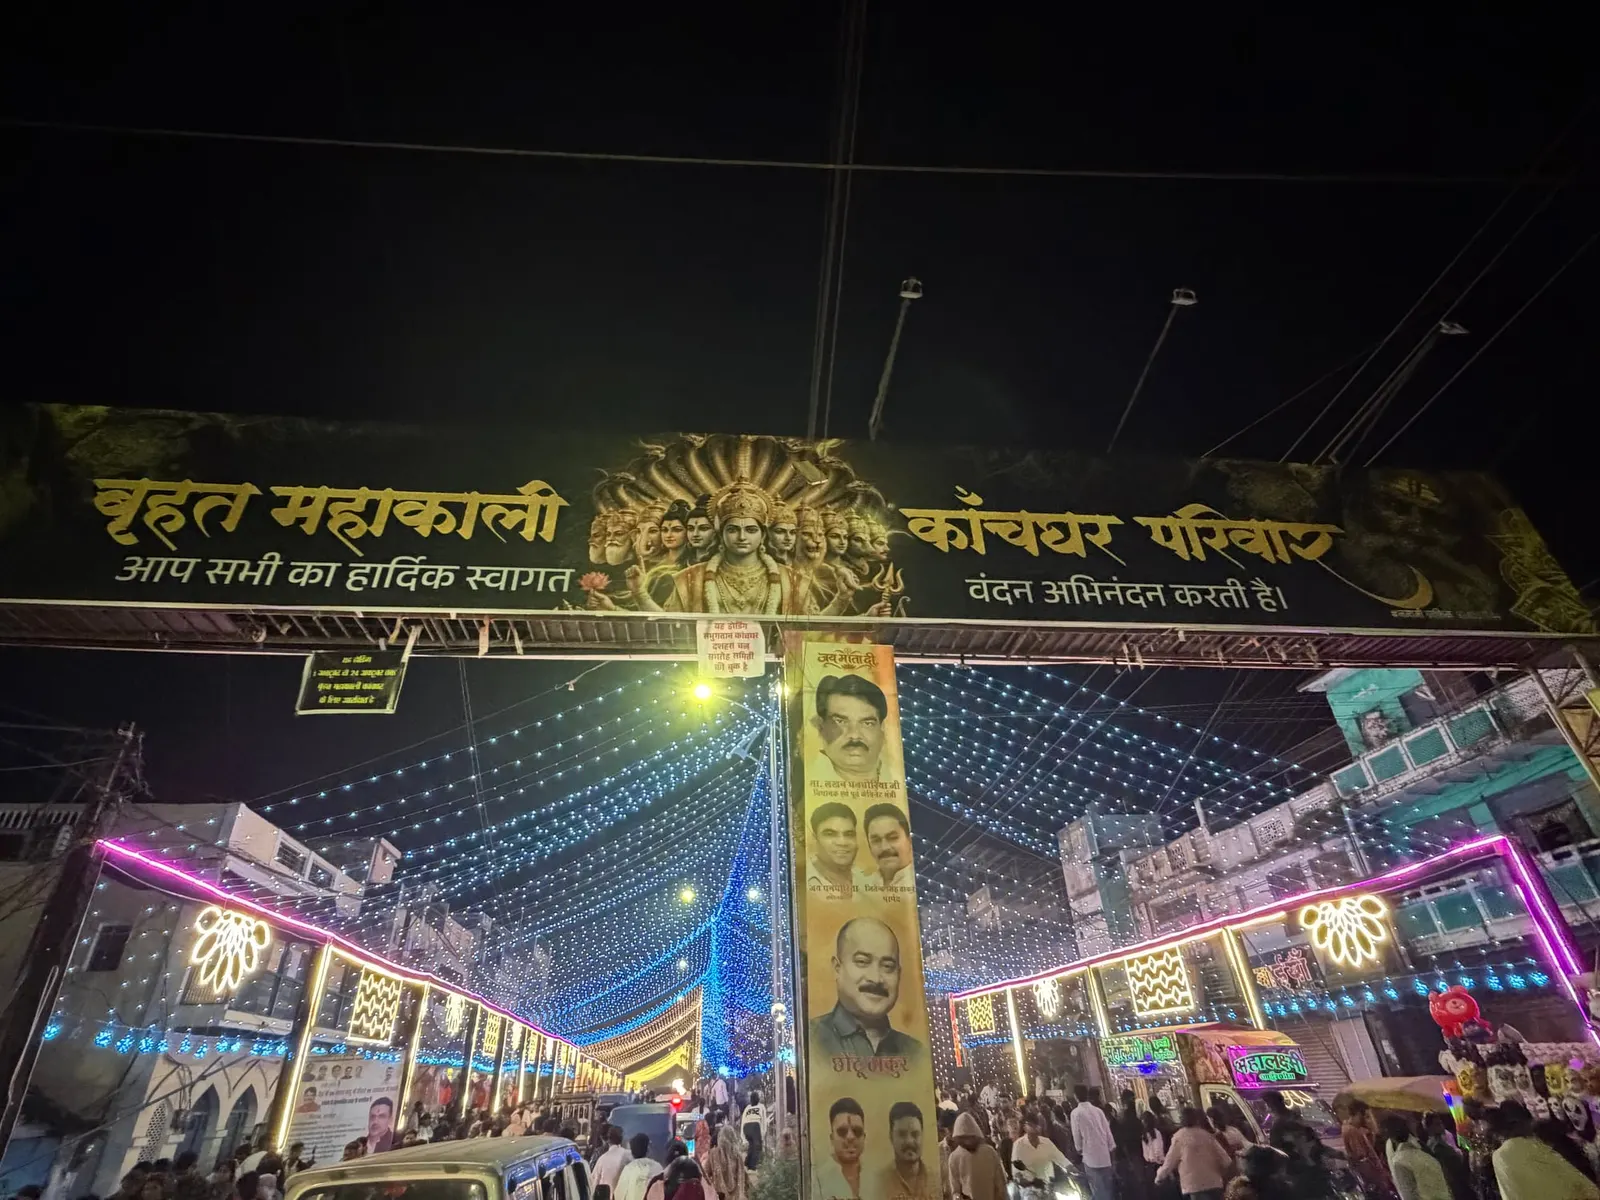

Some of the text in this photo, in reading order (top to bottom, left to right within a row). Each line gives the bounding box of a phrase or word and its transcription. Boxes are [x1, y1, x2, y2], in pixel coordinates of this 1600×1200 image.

[270, 479, 571, 556] महाकाली
[1132, 503, 1345, 570] परिवार
[115, 552, 576, 592] आप सभी का हार्दिक स्वागत
[965, 572, 1289, 612] वंदन अभिनंदन करती है।
[714, 622, 724, 630] यह
[712, 642, 734, 650] दशहरा
[817, 652, 838, 664] जय
[863, 652, 877, 667] दी
[1233, 1049, 1308, 1076] महालक्ष्मी
